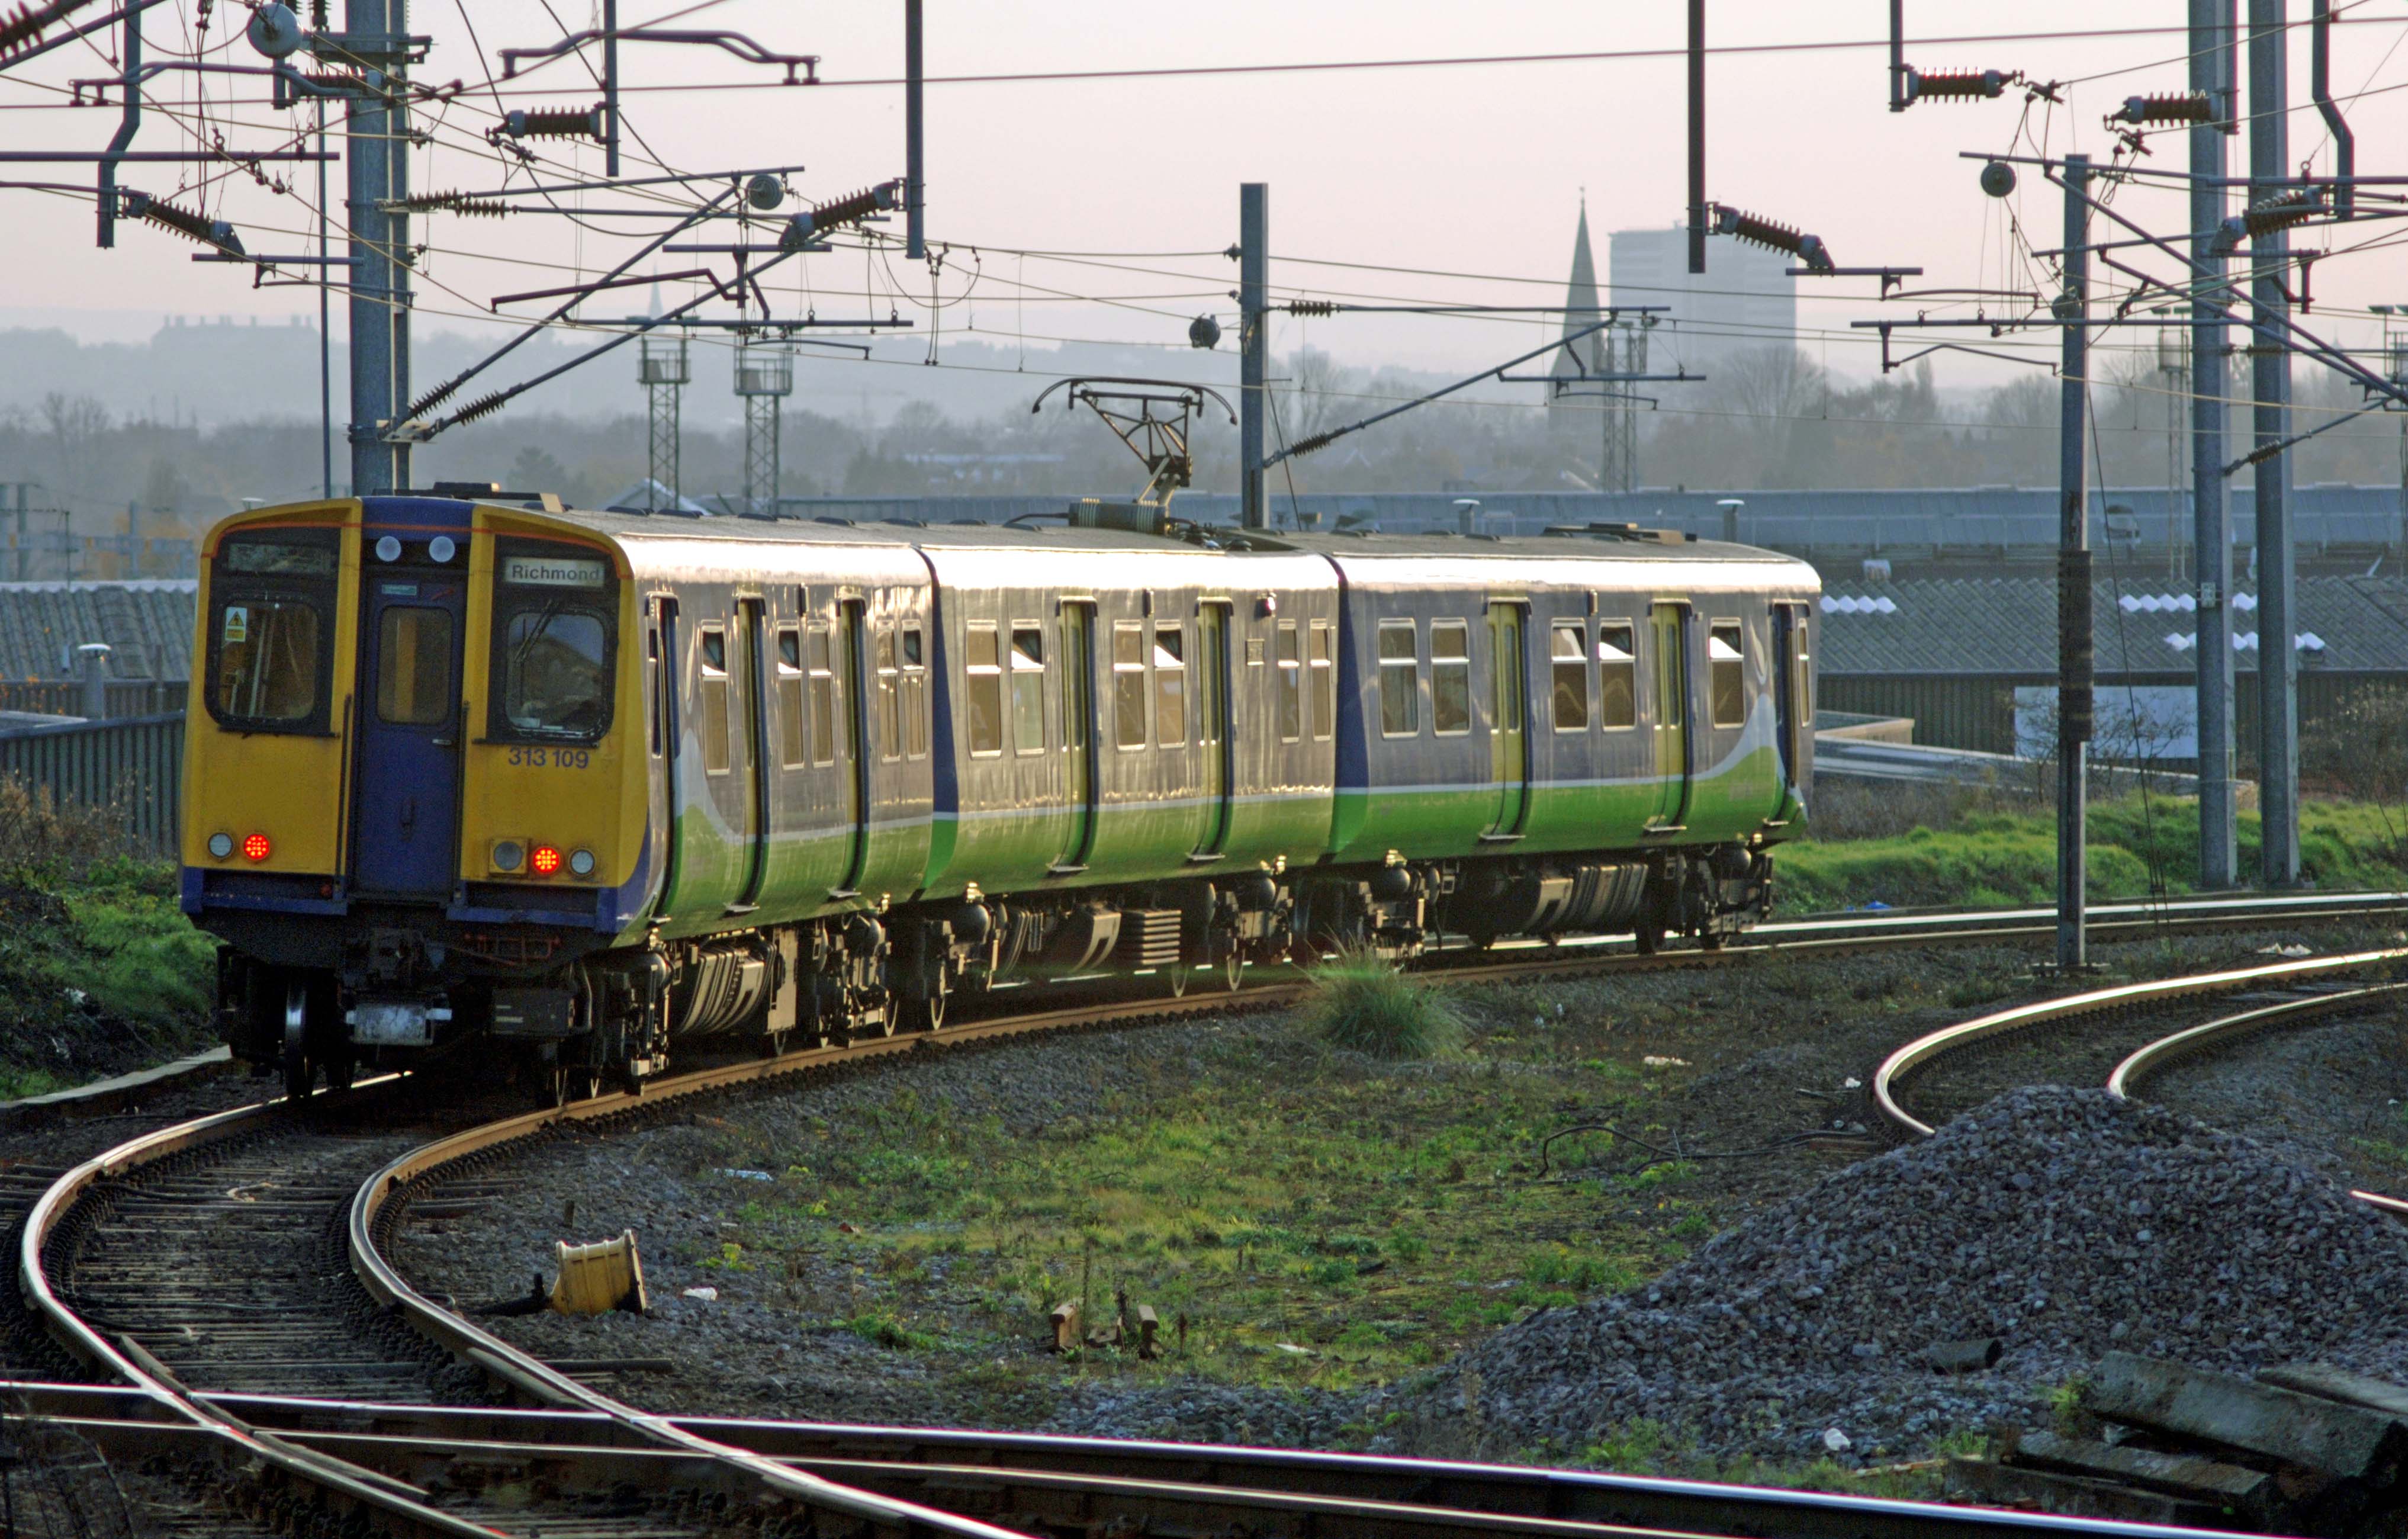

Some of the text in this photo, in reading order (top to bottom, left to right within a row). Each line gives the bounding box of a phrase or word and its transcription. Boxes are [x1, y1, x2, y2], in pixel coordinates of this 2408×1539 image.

[512, 564, 599, 581] Richmond
[509, 746, 589, 769] 313 109
